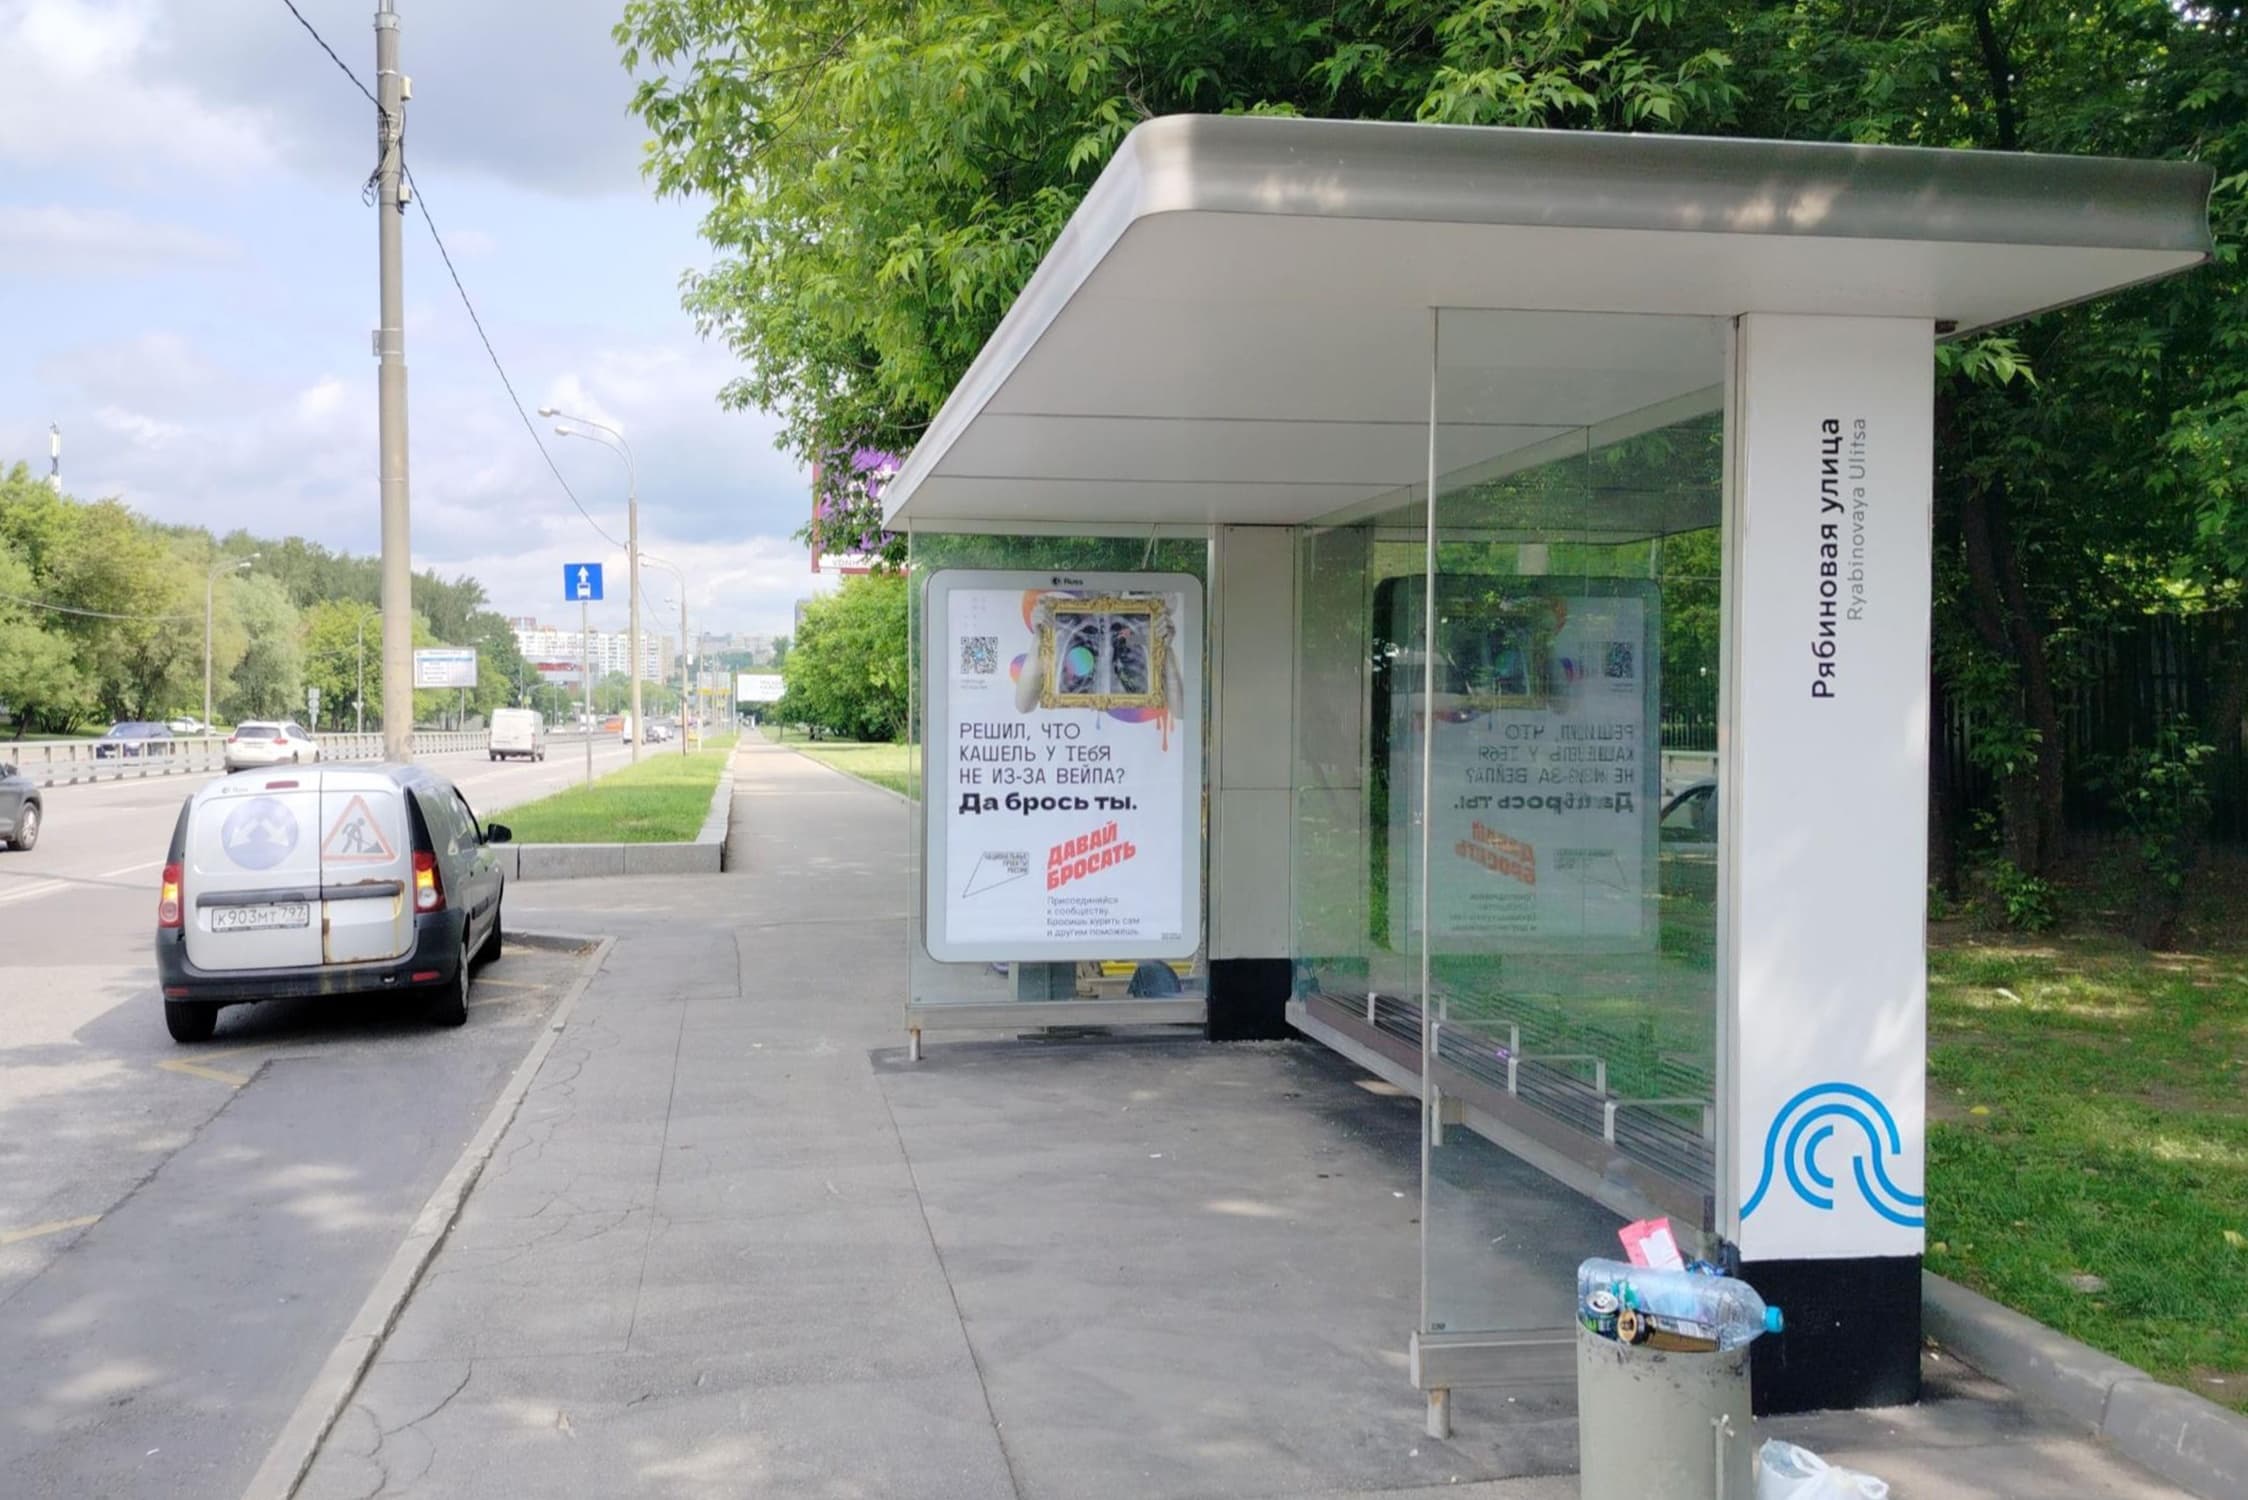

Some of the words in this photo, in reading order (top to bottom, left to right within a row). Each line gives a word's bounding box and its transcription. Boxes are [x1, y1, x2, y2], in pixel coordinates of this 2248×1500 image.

[1821, 418, 1845, 514] улица
[1847, 418, 1867, 480] Ulitsa
[1847, 487, 1868, 621] Ryabinovaya
[1811, 523, 1839, 698] Рябиновая
[959, 722, 1031, 742] РЕШИЛ,
[1041, 722, 1081, 740] ЧТО
[959, 745, 1036, 762] КАШЕЛЬ
[1046, 745, 1056, 762] У
[959, 767, 982, 784] НЕ
[992, 767, 1046, 784] ИЗ-ЗА
[1056, 764, 1126, 784] ВЕЙПА?
[959, 792, 999, 815] Да
[1005, 792, 1089, 815] брось
[1093, 796, 1137, 811] ты.
[1046, 841, 1137, 891] БРОСАТЬ
[1047, 820, 1118, 870] ДАВАЙ
